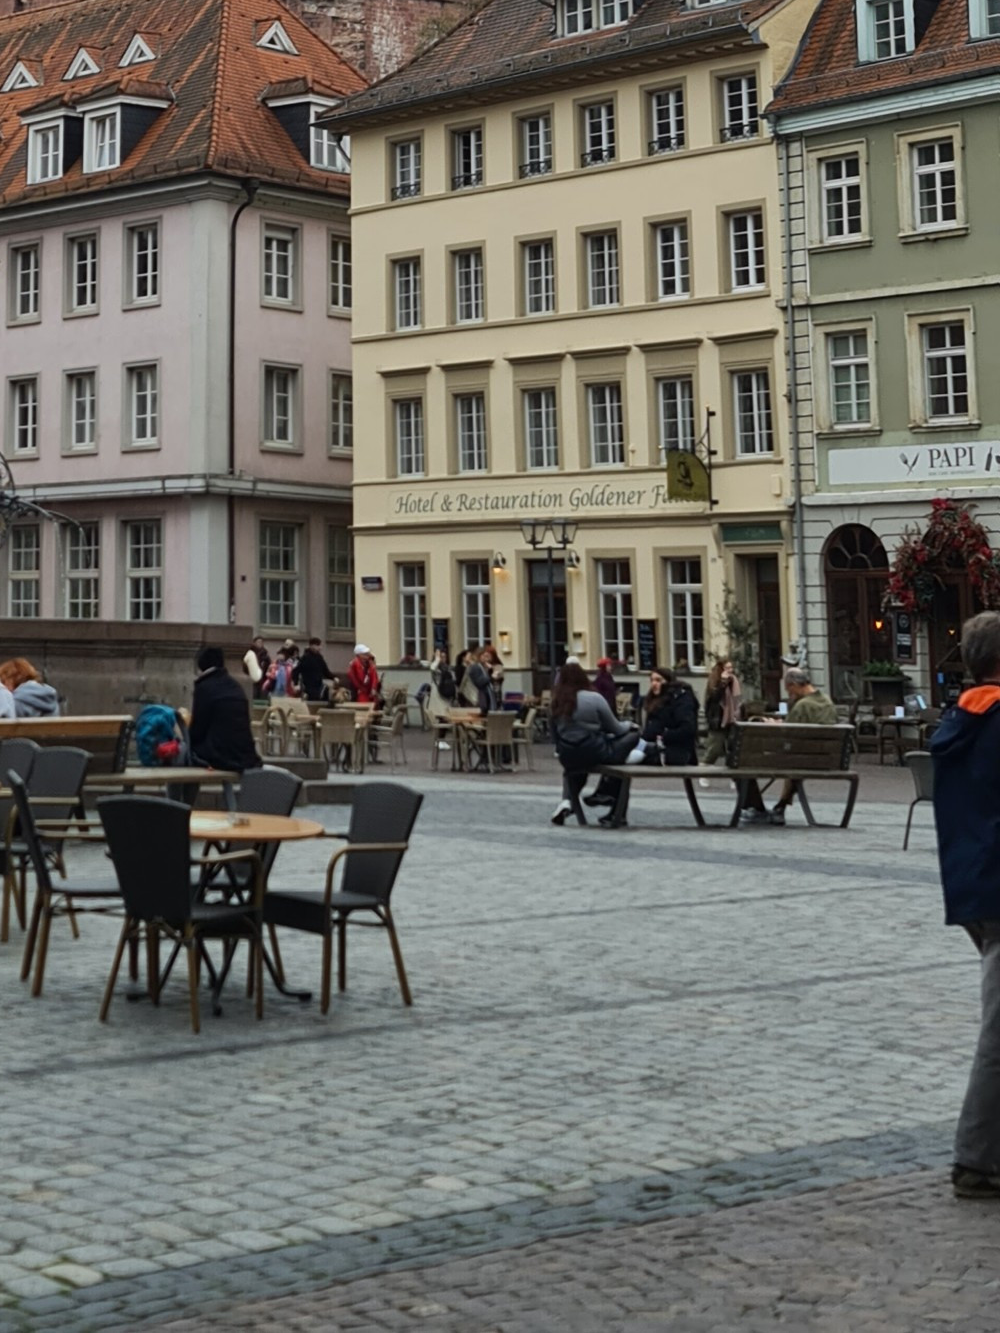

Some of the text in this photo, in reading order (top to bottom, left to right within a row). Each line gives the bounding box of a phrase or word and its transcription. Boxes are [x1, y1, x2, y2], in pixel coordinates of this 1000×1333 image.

[928, 446, 976, 468] PAPI
[395, 492, 438, 514] Hotel
[440, 493, 453, 513] &
[456, 488, 563, 512] Restauration
[569, 484, 646, 511] Goldener
